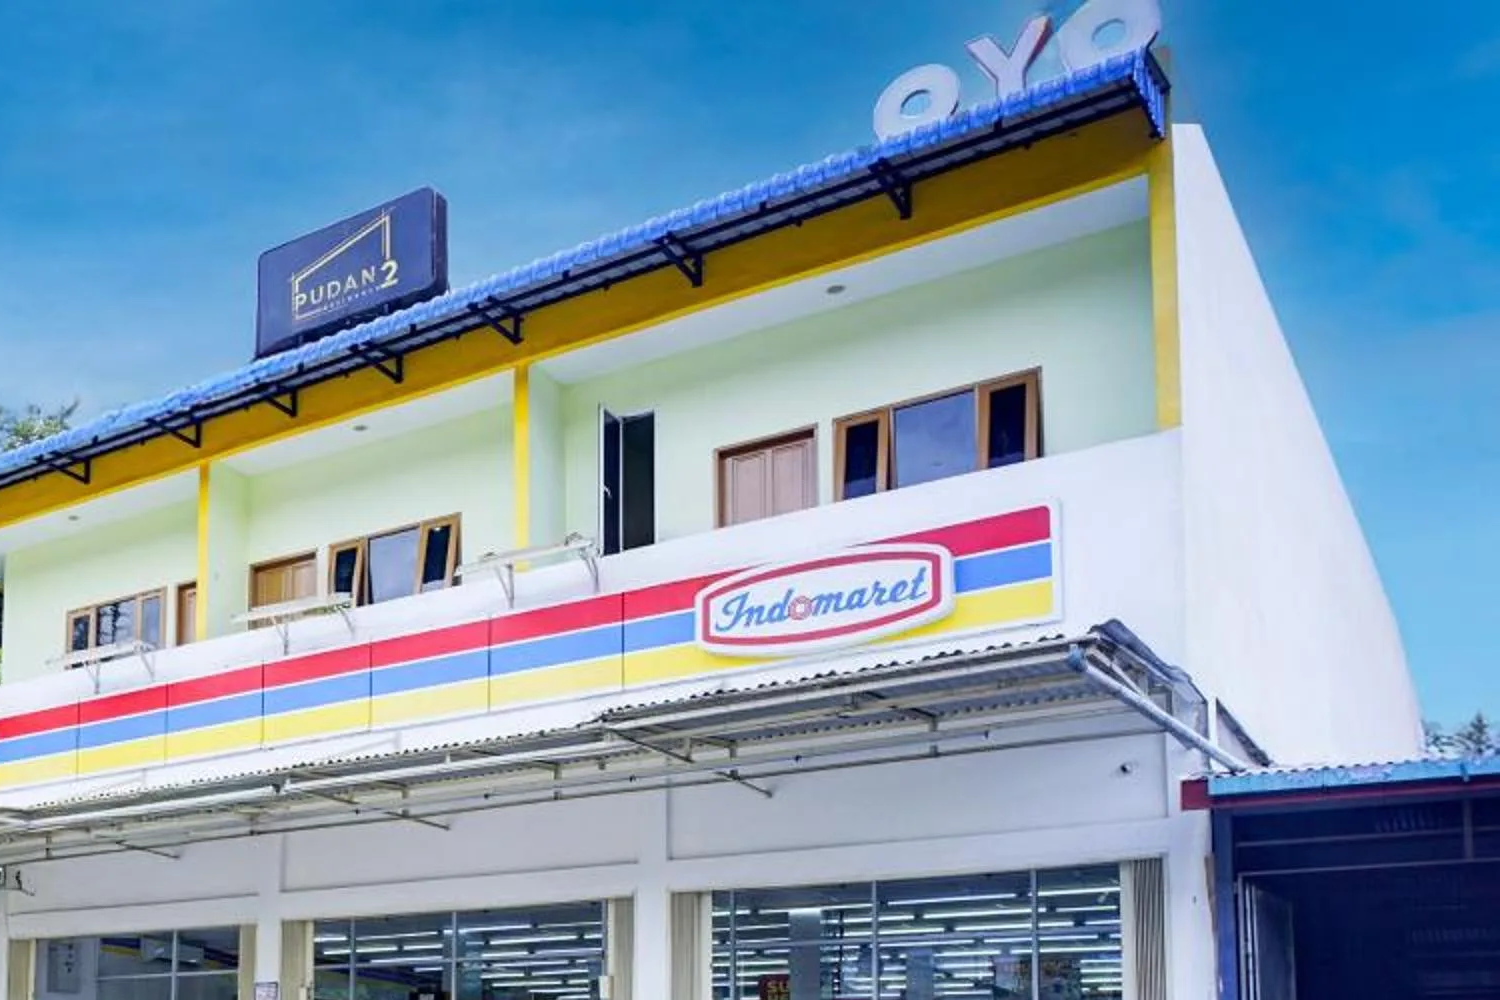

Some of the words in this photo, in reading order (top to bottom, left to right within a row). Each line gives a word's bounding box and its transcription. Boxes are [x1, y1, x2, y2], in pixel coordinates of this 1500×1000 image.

[873, 0, 1162, 143] OYO
[295, 265, 376, 313] PUDAN
[380, 260, 399, 289] 2
[714, 567, 927, 632] Indomaret
